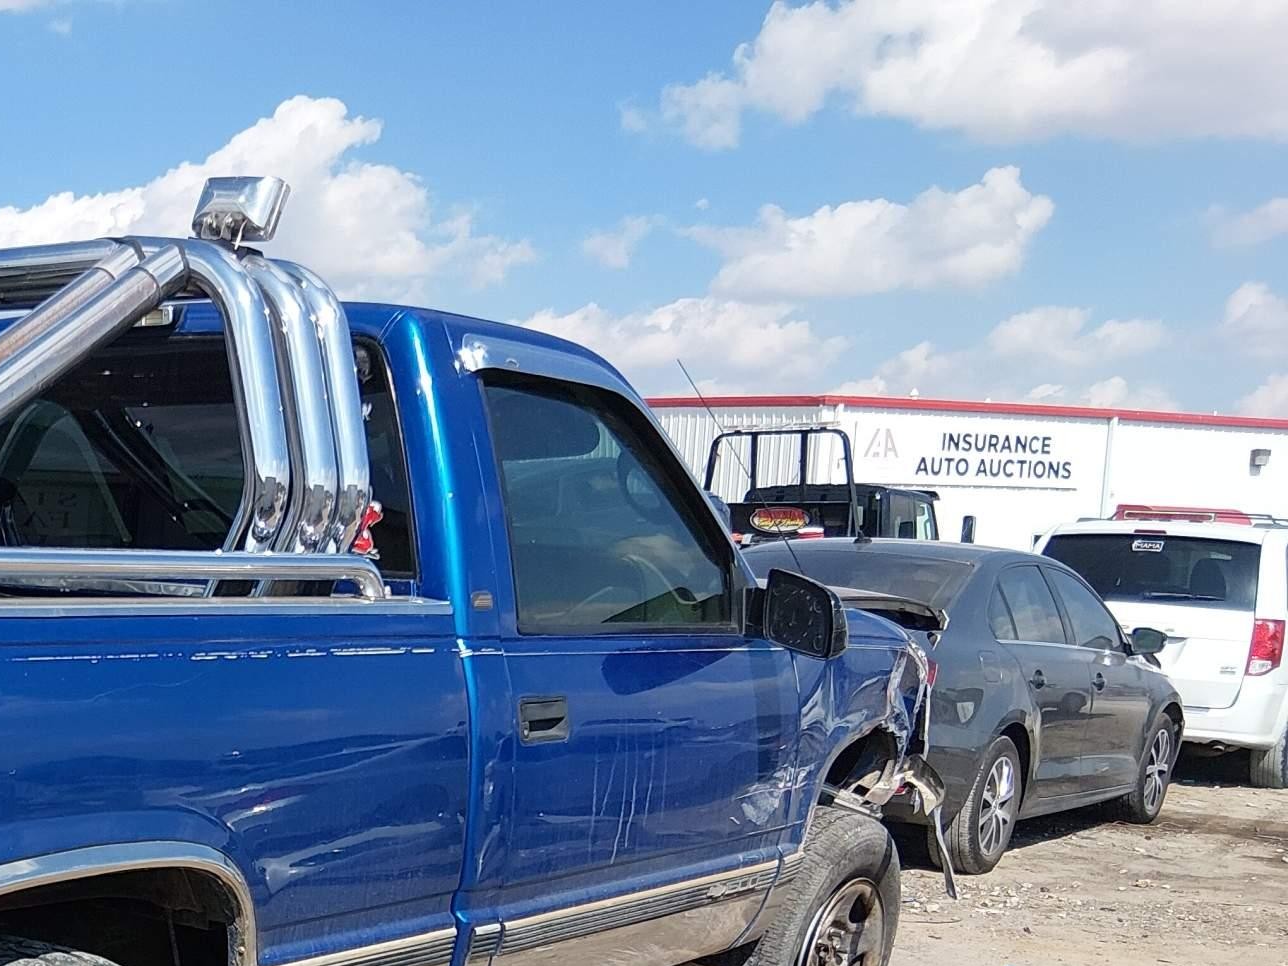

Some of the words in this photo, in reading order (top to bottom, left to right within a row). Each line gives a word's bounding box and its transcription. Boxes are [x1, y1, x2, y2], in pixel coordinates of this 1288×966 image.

[941, 432, 1052, 455] INSURANCE
[915, 457, 969, 476] AUTO
[975, 458, 1072, 479] AUCTIONS
